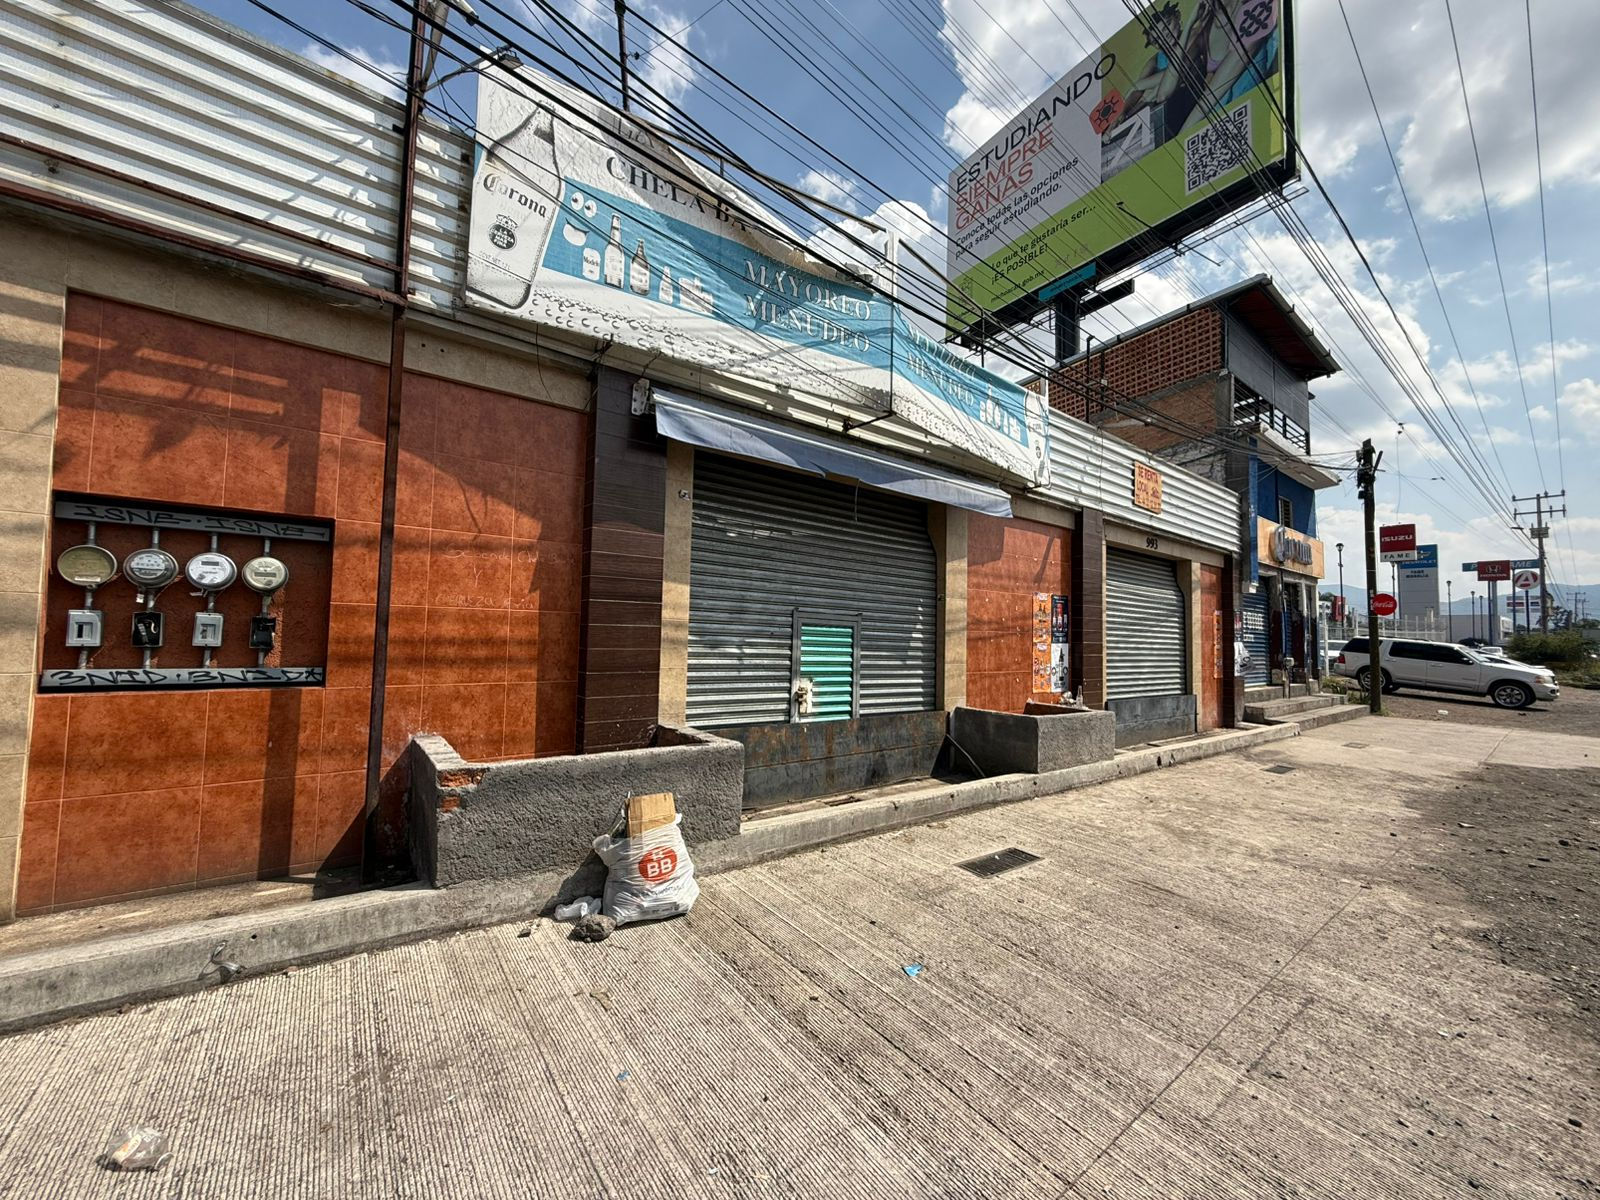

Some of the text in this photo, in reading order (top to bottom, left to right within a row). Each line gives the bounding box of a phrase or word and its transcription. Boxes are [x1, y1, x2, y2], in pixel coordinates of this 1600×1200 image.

[956, 53, 1116, 193] ESTUDIANDO
[483, 172, 547, 218] Corona
[606, 156, 705, 214] CHELA
[956, 122, 1053, 212] SIEMPRE
[956, 161, 1033, 230] GANAS
[955, 156, 1079, 247] Conoce todas las opciones
[974, 220, 1002, 246] seguir
[1002, 250, 1018, 268] que
[1019, 243, 1029, 254] te
[743, 258, 871, 321] MAYOREO
[743, 293, 870, 352] MENUDEO
[1146, 536, 1158, 550] 993
[1381, 534, 1413, 542] ISUZU
[1384, 552, 1411, 560] FAME
